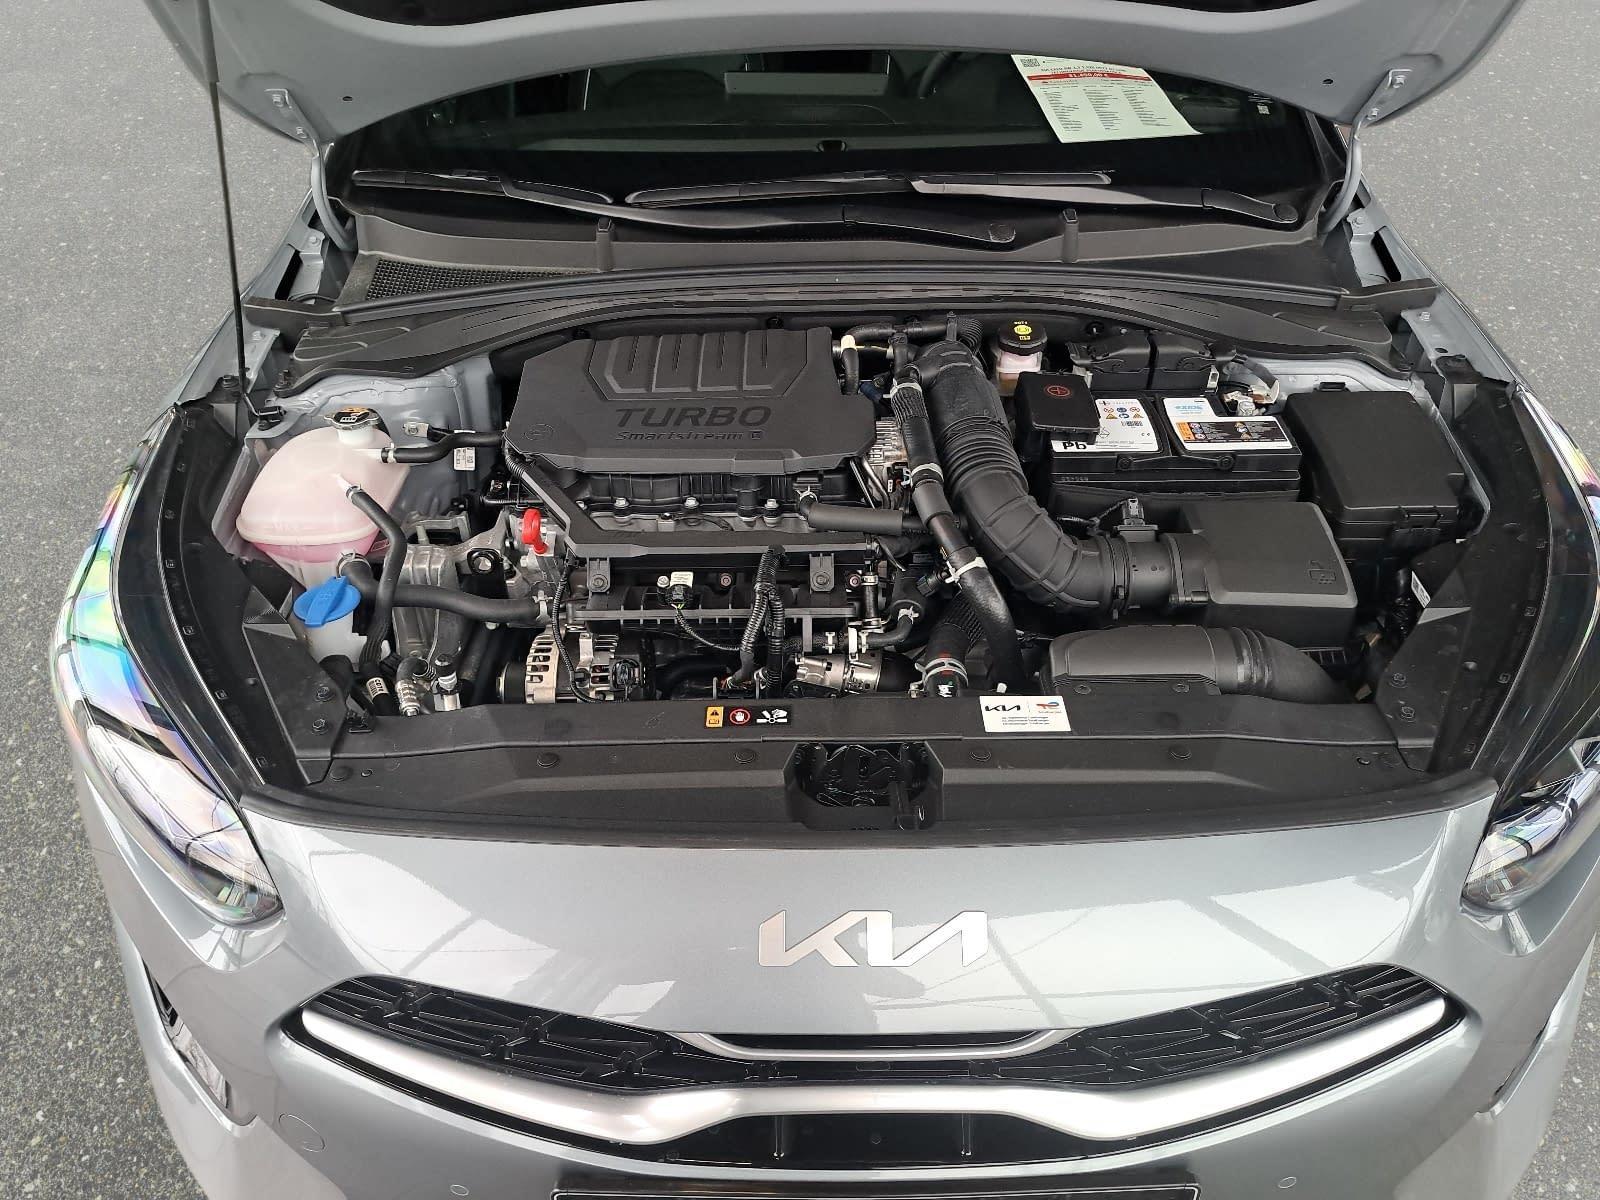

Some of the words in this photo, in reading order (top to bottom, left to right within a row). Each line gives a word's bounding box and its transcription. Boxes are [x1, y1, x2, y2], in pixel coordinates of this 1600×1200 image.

[616, 406, 772, 428] TURBO
[615, 430, 744, 441] Smartstream
[1062, 441, 1087, 450] Pb
[984, 704, 1021, 712] KIA
[758, 910, 988, 967] KIA
